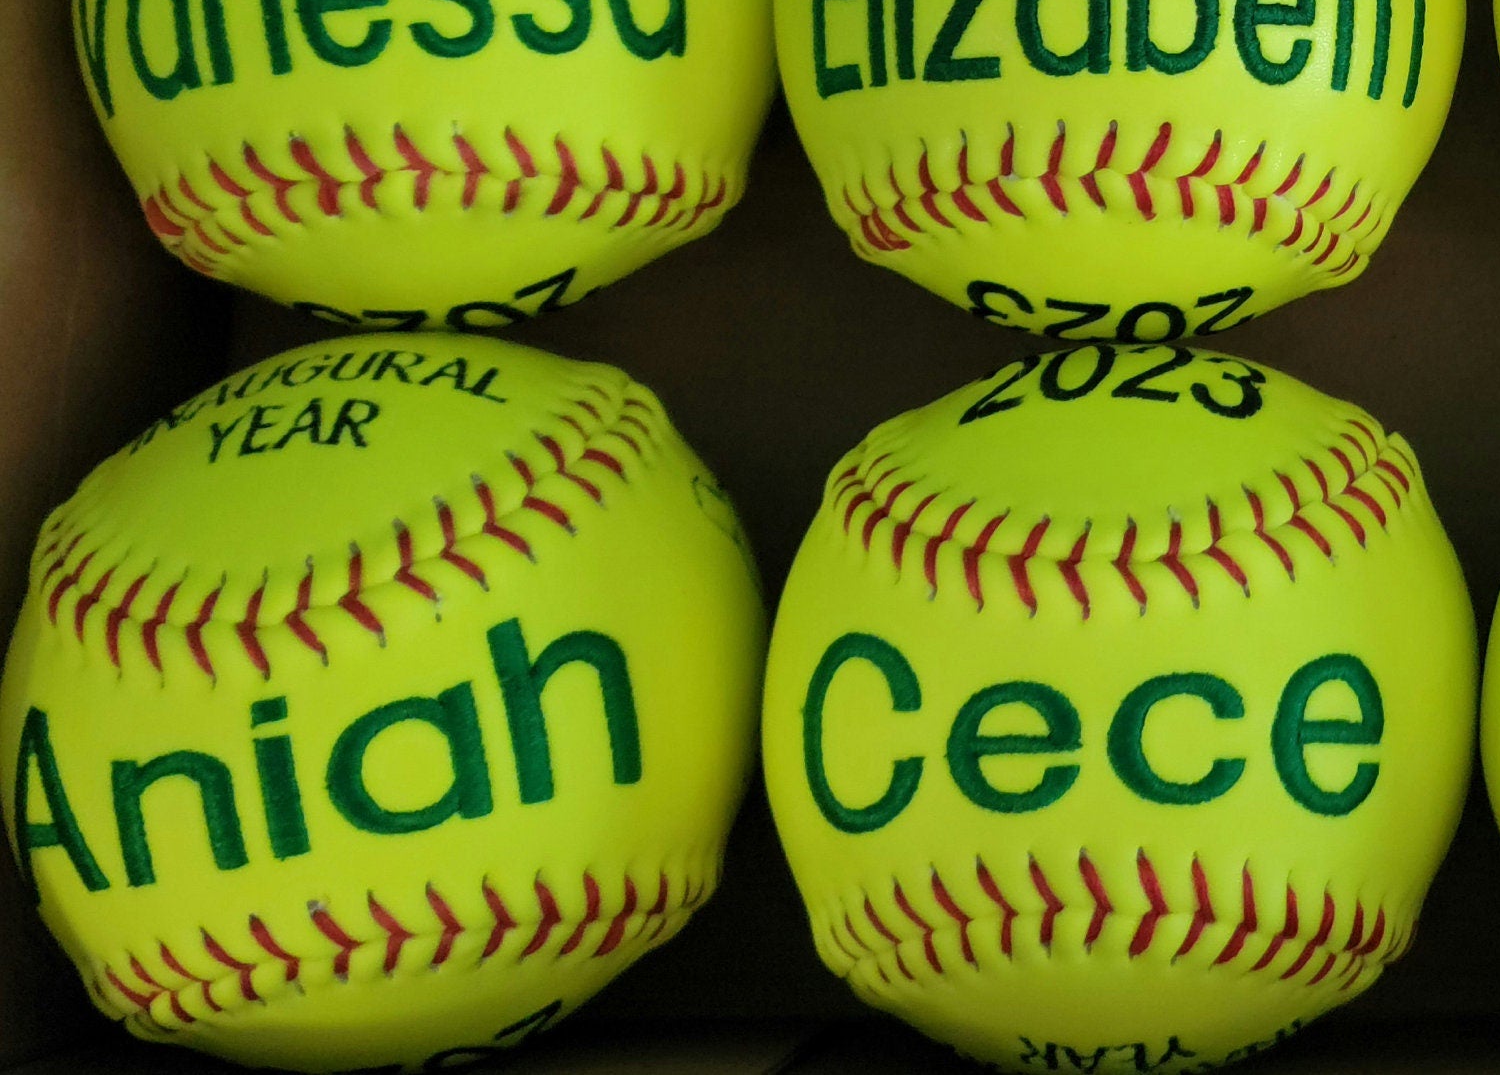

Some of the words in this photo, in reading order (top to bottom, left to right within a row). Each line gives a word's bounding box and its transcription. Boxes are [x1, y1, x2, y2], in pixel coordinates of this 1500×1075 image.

[967, 280, 1257, 345] 2023
[959, 345, 1266, 426] 2023
[209, 397, 381, 465] YEAR
[14, 616, 643, 905] Aniah
[803, 631, 1386, 836] Cece
